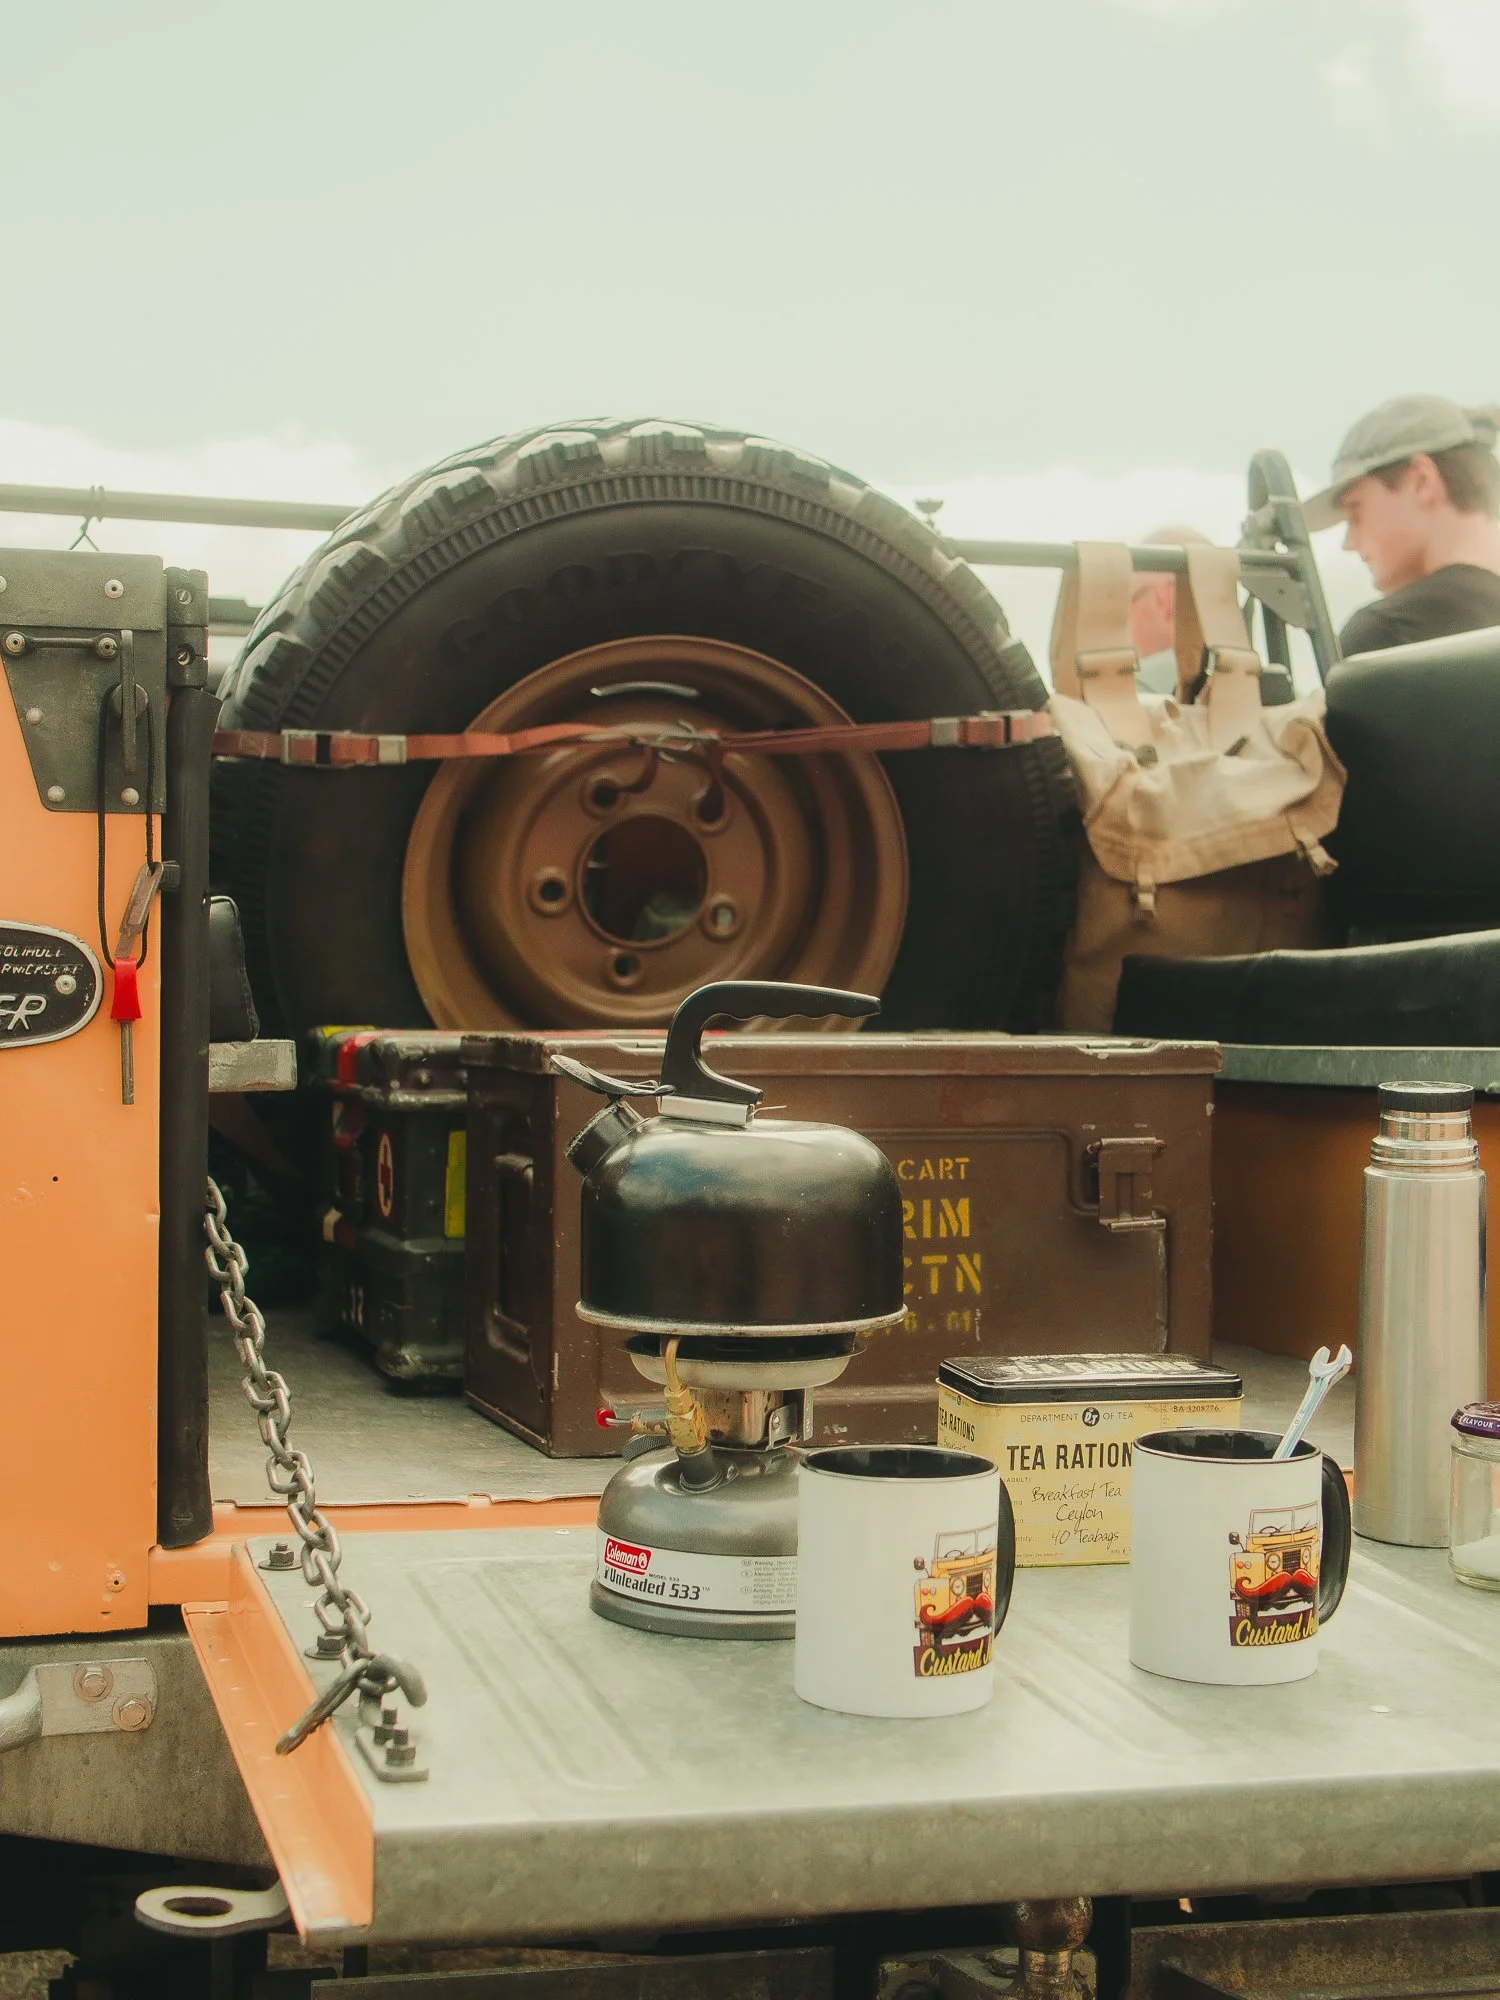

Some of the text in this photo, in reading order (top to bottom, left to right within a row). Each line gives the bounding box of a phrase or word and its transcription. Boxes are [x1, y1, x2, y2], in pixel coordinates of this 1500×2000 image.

[0, 945, 62, 958] OLIHULL
[897, 1157, 970, 1180] CART
[1020, 1413, 1078, 1423] DEPARTMENT
[1102, 1413, 1115, 1421] OF
[1117, 1412, 1134, 1420] TEA
[1173, 1405, 1185, 1413] BA
[948, 1413, 976, 1442] RATIONS
[1462, 1417, 1493, 1429] FLAVOUR
[1007, 1444, 1046, 1471] TEA
[1032, 1481, 1122, 1503] Breakfast Tea
[1056, 1502, 1103, 1532] Ceylon
[1052, 1528, 1120, 1550] 40 Teabags
[606, 1541, 638, 1567] Coleman
[609, 1567, 666, 1596] Unleaded
[648, 1572, 667, 1580] MODEL
[1236, 1613, 1301, 1646] Custard
[919, 1641, 983, 1676] Custard
